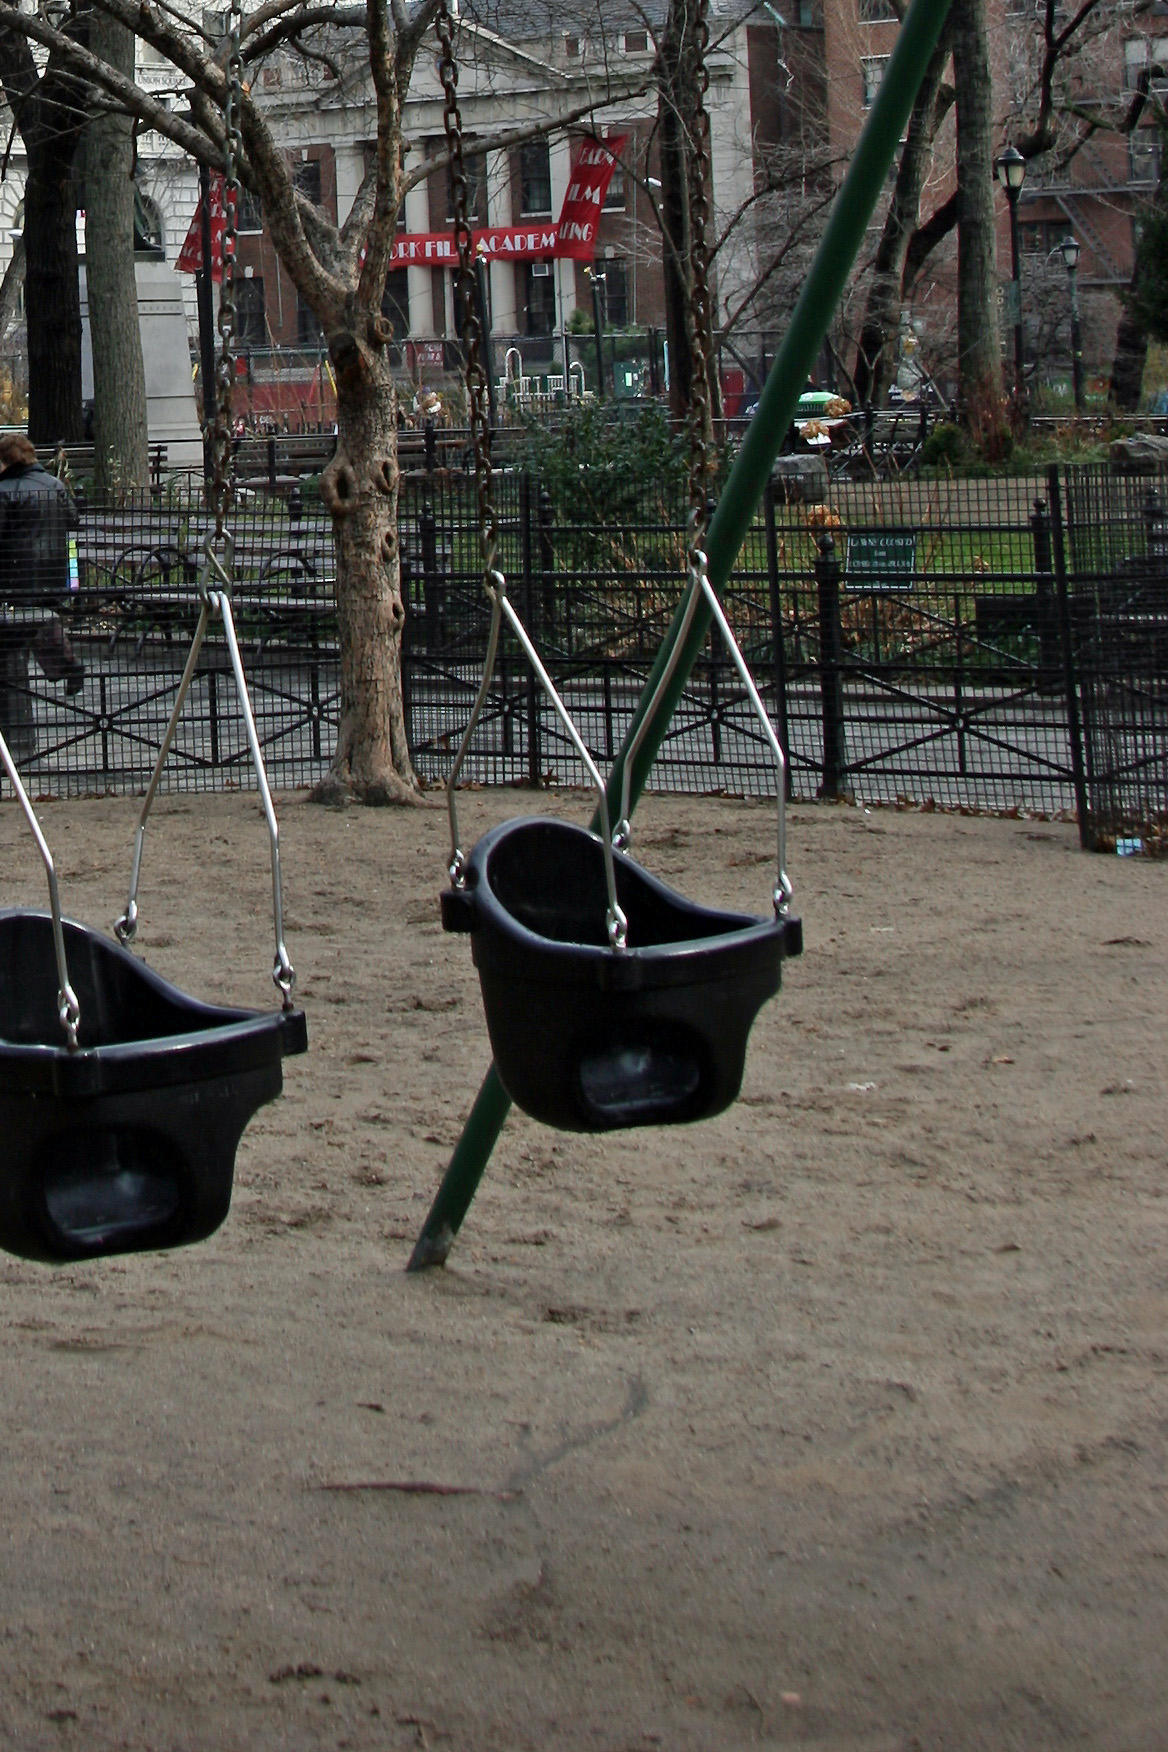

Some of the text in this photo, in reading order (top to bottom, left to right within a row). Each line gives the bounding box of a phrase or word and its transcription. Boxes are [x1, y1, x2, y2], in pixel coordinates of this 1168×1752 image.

[567, 183, 601, 205] ILM
[389, 241, 422, 259] ORK
[476, 231, 558, 253] ACADEM
